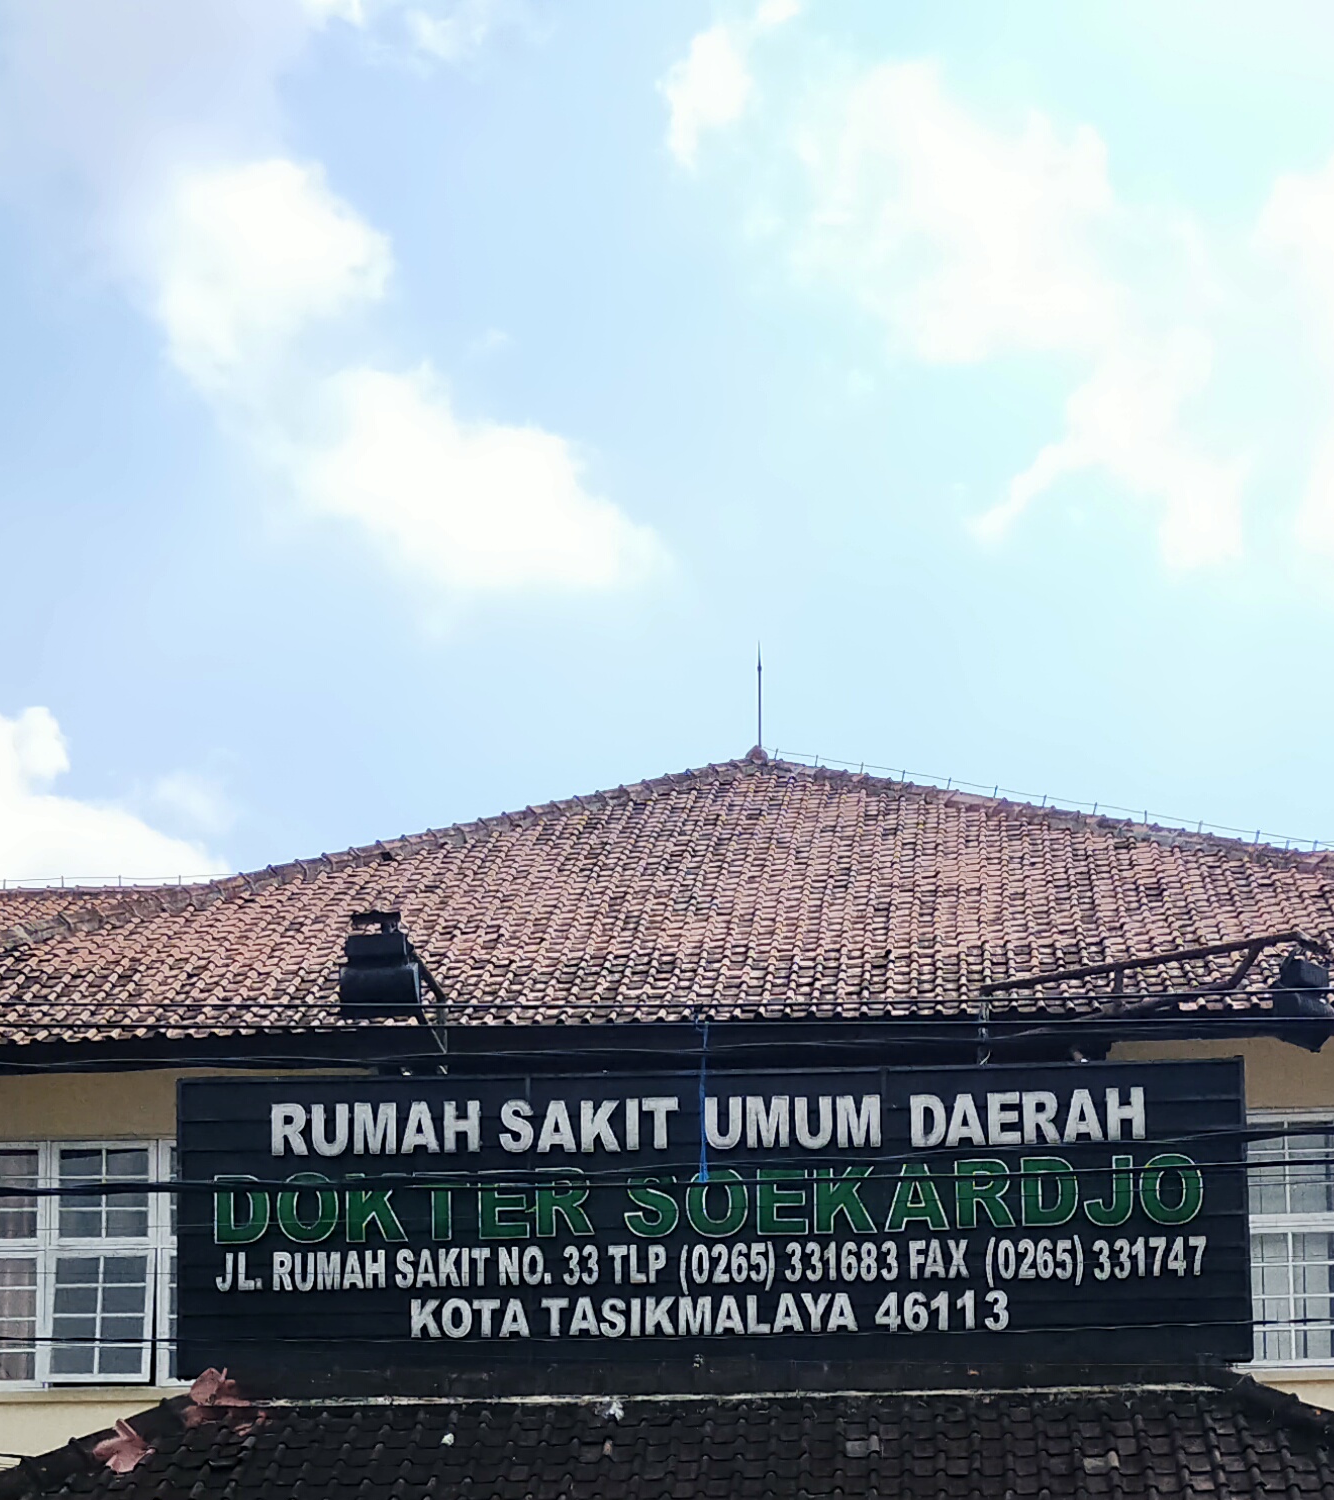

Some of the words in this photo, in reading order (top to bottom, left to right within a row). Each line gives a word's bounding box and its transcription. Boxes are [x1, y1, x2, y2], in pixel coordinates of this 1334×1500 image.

[270, 1100, 481, 1157] RUMAH
[498, 1096, 679, 1154] SAKIT
[704, 1094, 882, 1149] UMUM
[909, 1086, 1147, 1149] DAERAH
[212, 1166, 596, 1245] DOKTER
[623, 1152, 1204, 1238] SOEKARDJO
[214, 1252, 264, 1292] JL.
[271, 1249, 387, 1292] RUMAH
[394, 1247, 492, 1289] SAKIT
[497, 1246, 552, 1286] NO.
[562, 1244, 599, 1286] 33
[607, 1244, 666, 1285] TLP
[678, 1241, 776, 1294] (0265)
[784, 1240, 900, 1283] 331683
[907, 1238, 969, 1280] FAX
[985, 1234, 1084, 1287] (0265)
[1091, 1235, 1207, 1279] 331747
[409, 1297, 531, 1339] KOTA
[540, 1293, 859, 1337] TASIKMALAYA
[874, 1290, 1009, 1333] 46113
